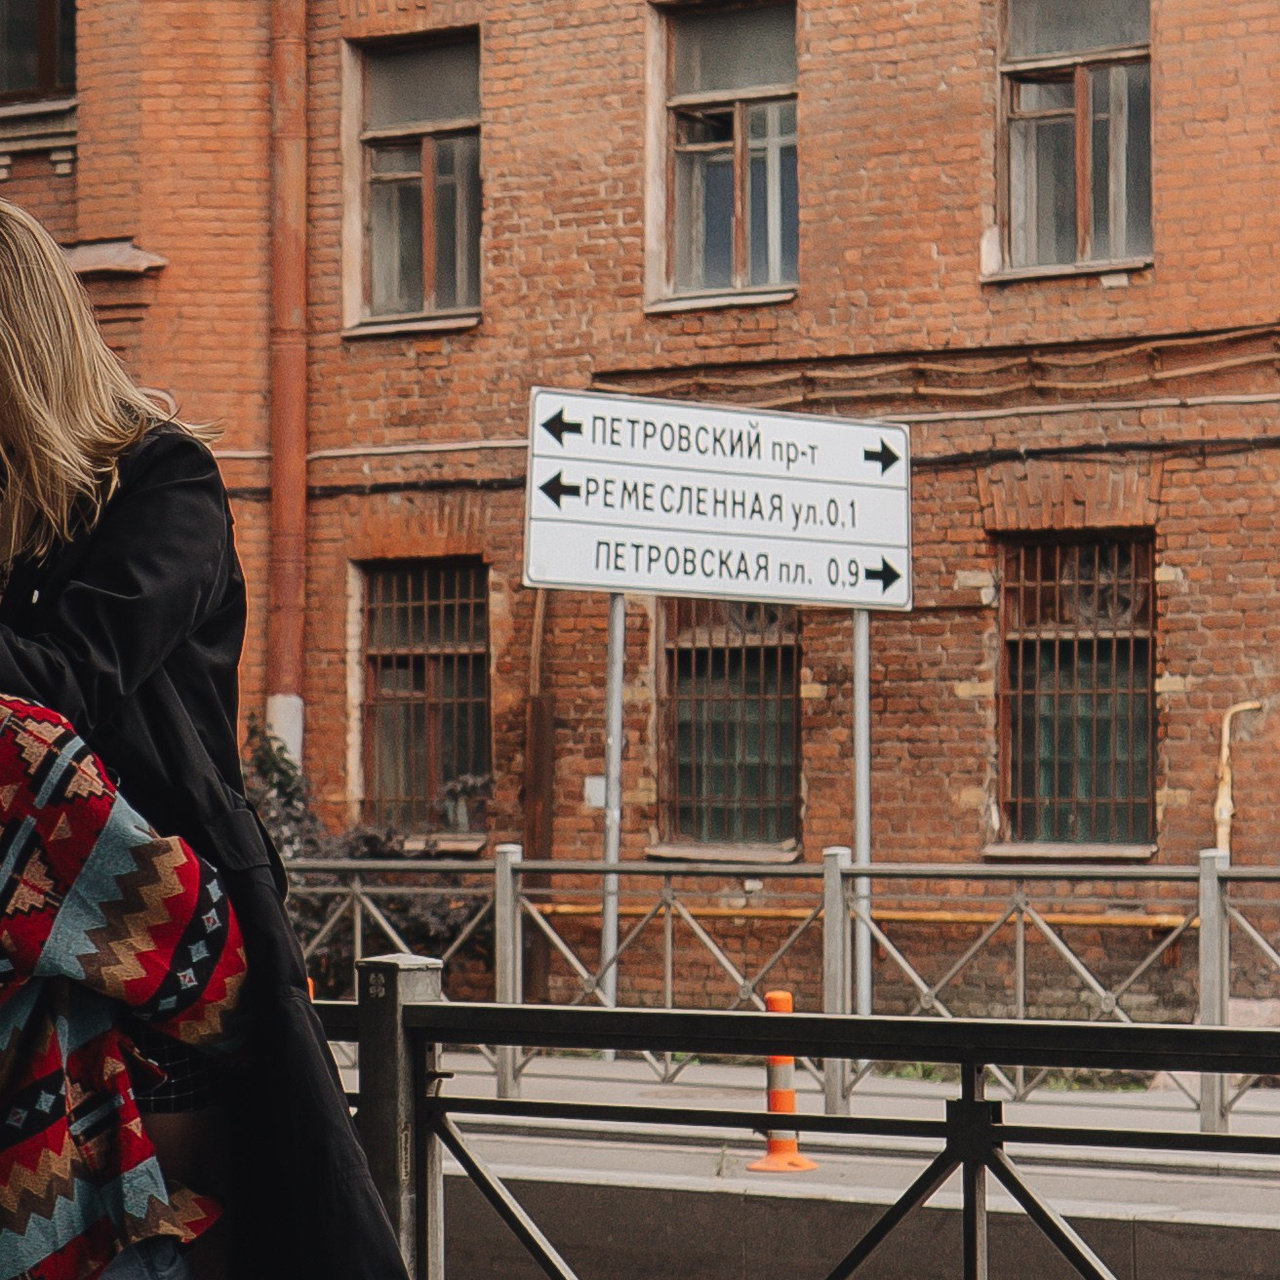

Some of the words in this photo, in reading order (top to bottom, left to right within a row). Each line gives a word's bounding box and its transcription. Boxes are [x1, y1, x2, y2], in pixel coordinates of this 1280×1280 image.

[592, 415, 761, 459] ПЕТРОВСКИЙ
[772, 440, 818, 470] пр-т
[585, 478, 783, 522] РЕМЕСЛЕННАЯ
[595, 541, 769, 582] ПЕТРОВСКАЯ
[779, 562, 812, 585] пл.
[828, 558, 859, 588] 0,9
